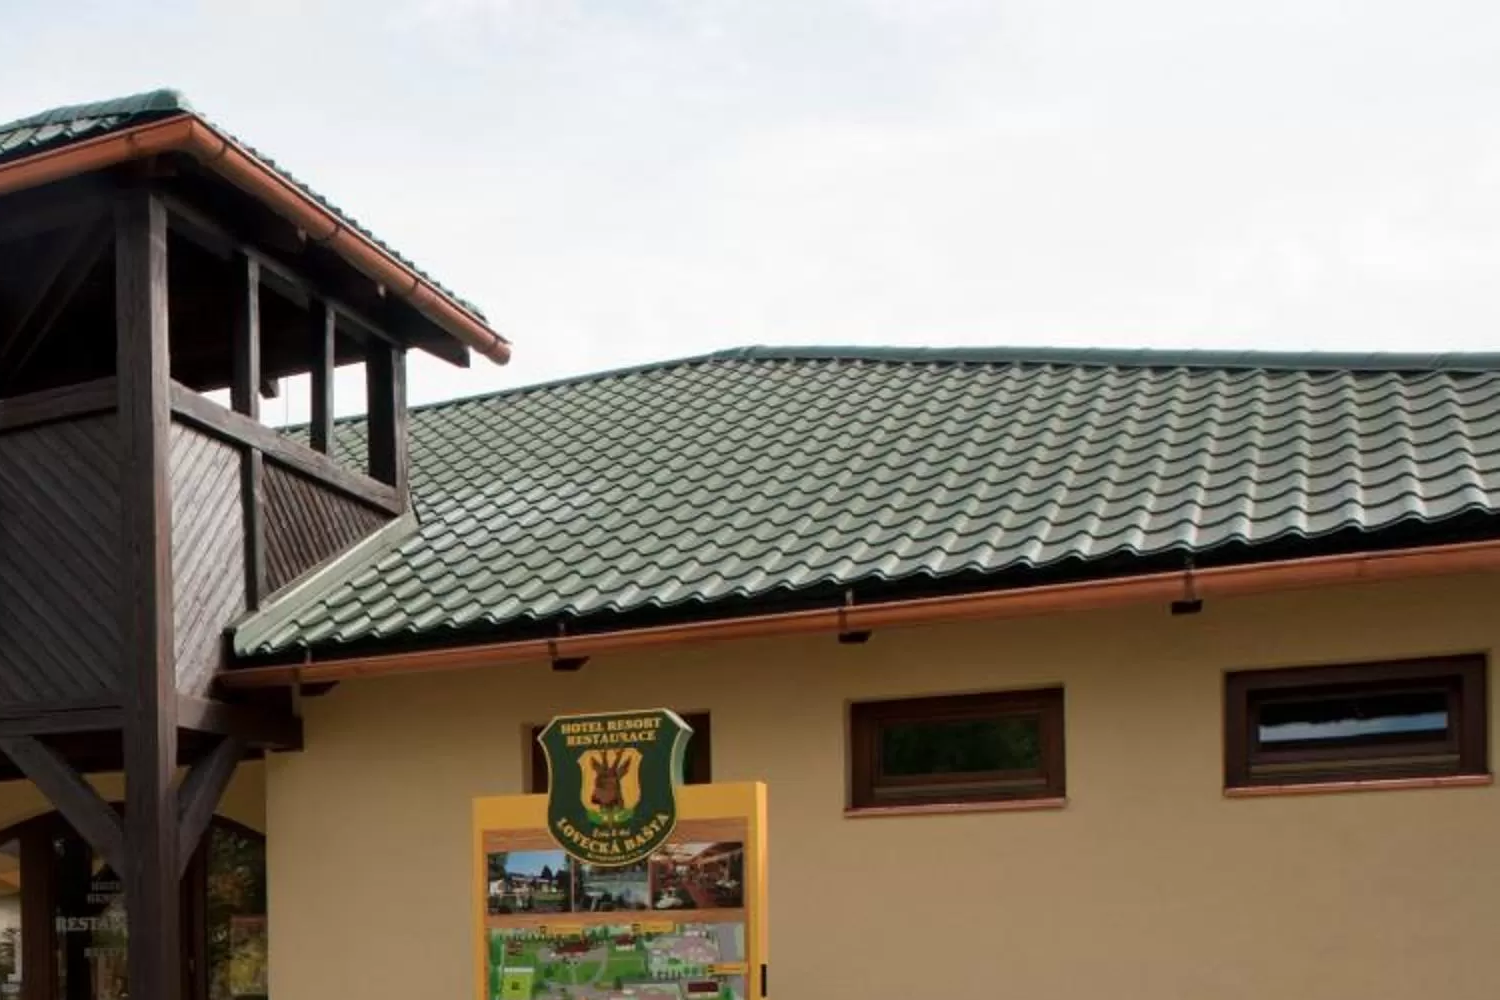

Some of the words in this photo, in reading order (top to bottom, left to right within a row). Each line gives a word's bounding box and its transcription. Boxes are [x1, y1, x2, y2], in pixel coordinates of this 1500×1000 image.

[561, 719, 605, 735] HOTEL
[607, 717, 663, 732] RESORT
[566, 729, 657, 746] RESTAURACE
